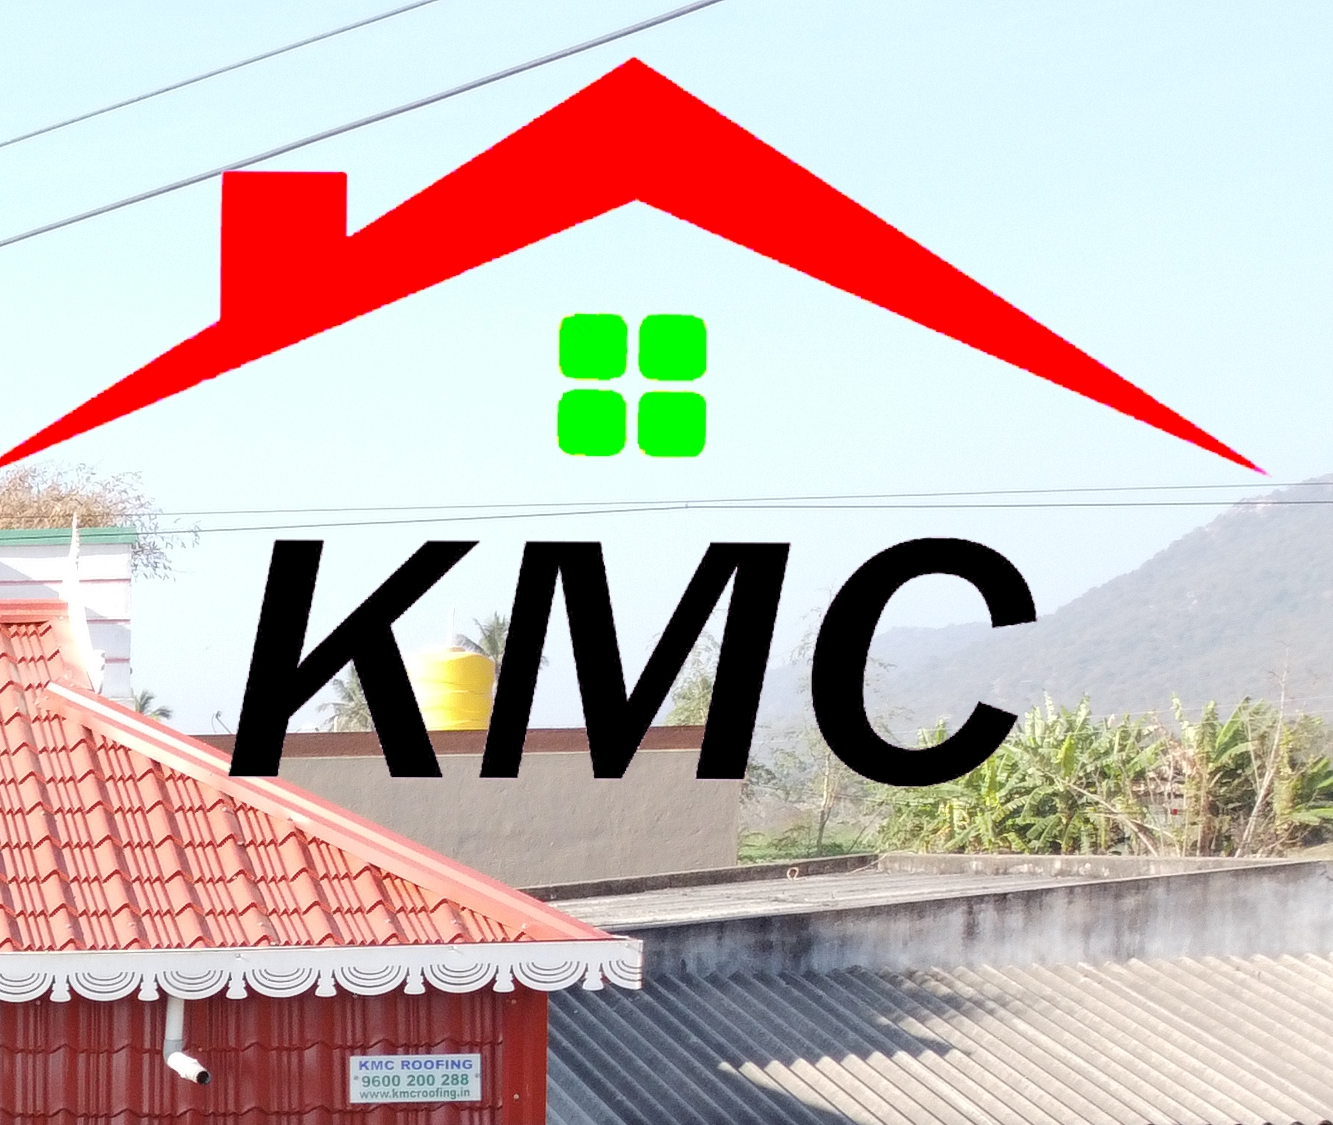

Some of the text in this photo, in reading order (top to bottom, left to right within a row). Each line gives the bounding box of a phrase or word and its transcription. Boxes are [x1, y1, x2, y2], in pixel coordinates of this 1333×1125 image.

[358, 1059, 473, 1071] KMC ROOFING
[361, 1073, 470, 1088] 9600 200 288
[359, 1087, 471, 1100] www.kmcroofing.in
